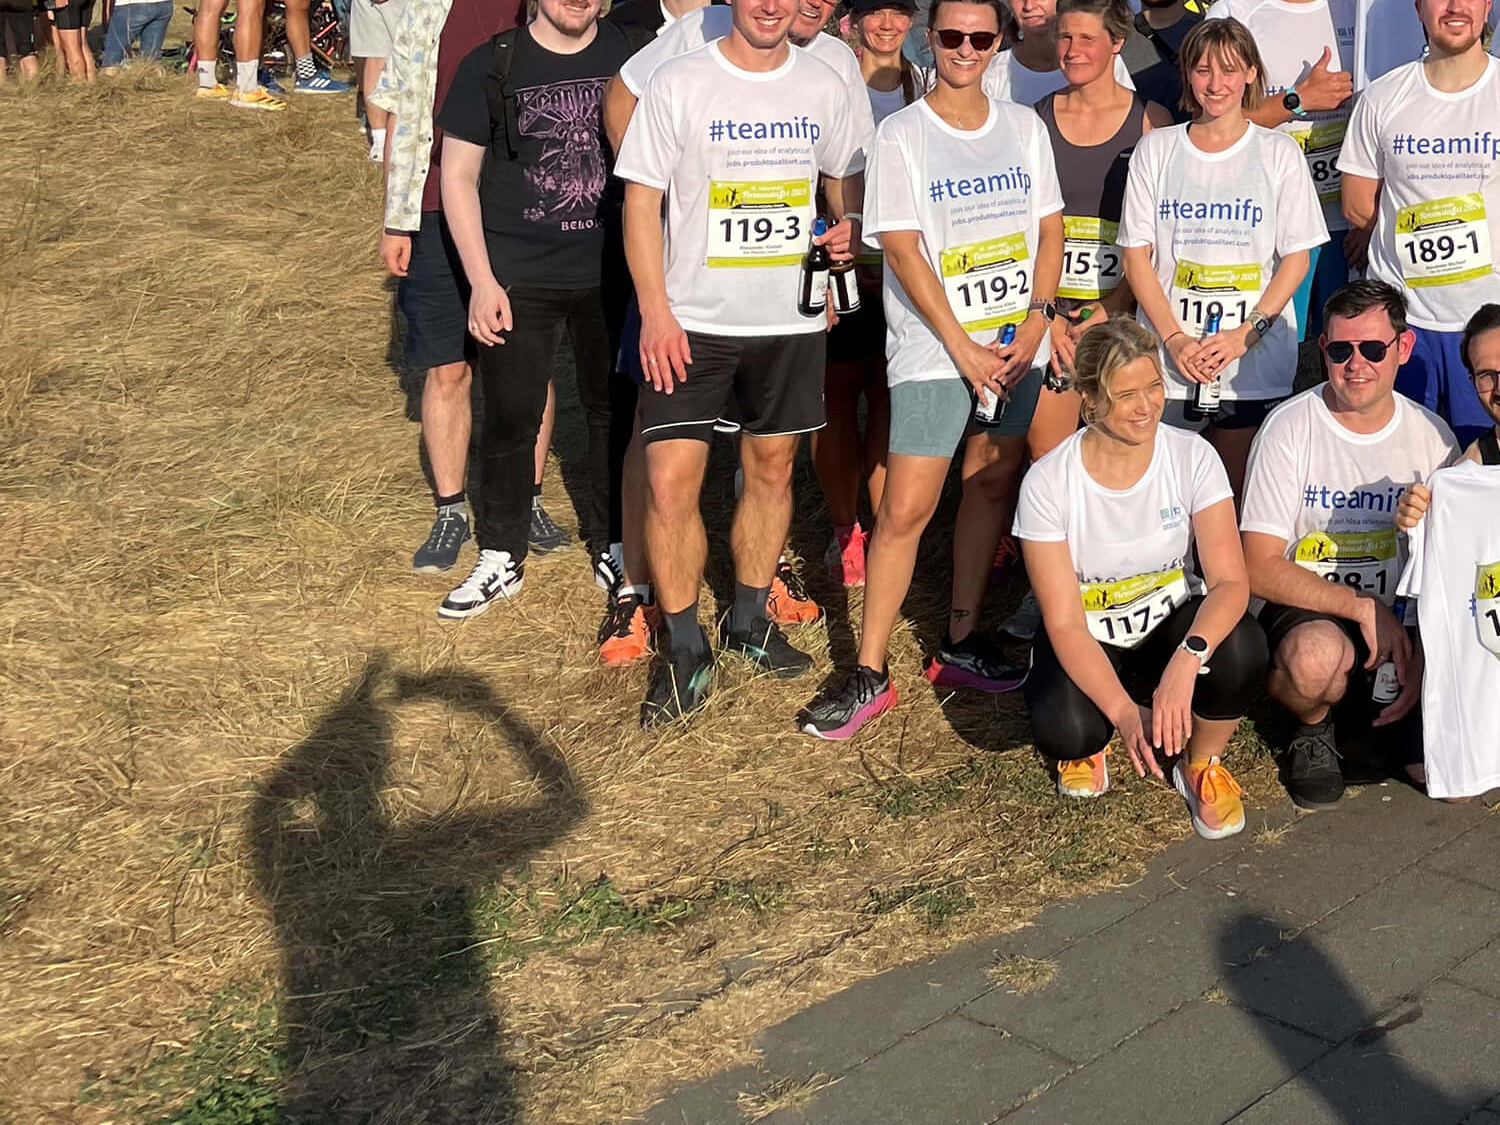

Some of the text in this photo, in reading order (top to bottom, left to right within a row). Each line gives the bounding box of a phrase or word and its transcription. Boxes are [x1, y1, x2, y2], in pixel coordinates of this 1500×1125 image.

[709, 116, 820, 145] #teamifp
[928, 166, 1032, 203] #teamifp
[720, 216, 800, 242] 119-3
[1159, 198, 1263, 227] #teamifp
[1404, 230, 1479, 265] 189-1
[957, 269, 1029, 307] 119-2
[1099, 594, 1176, 640] 117-1
